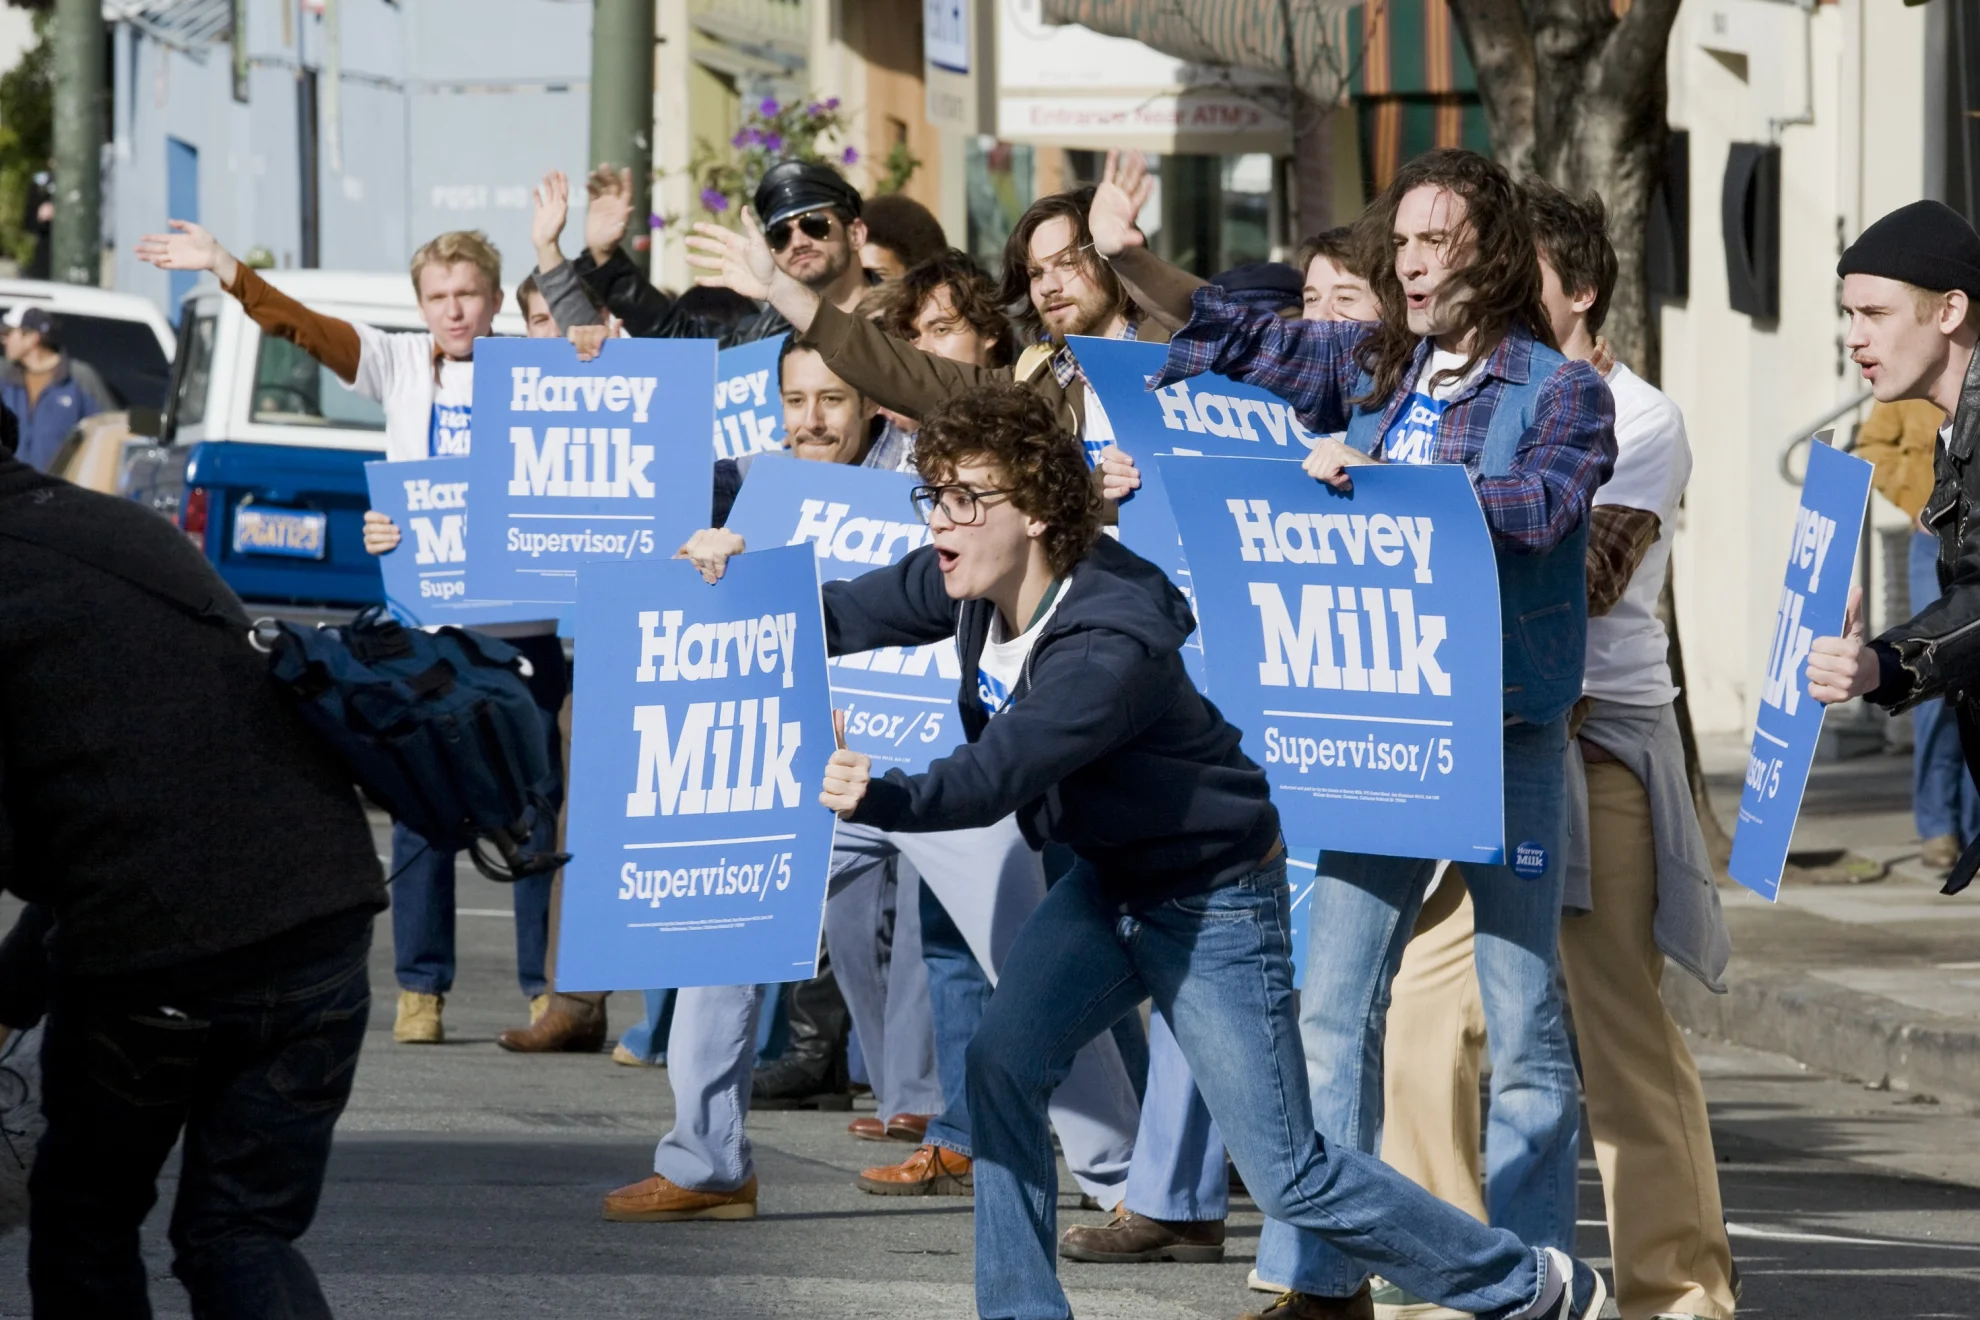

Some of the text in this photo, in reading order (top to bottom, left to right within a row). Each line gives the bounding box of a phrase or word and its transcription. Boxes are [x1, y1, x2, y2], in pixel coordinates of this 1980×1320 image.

[511, 366, 657, 423] Harvey
[508, 426, 655, 499] Milk
[713, 409, 783, 460] ilk
[403, 479, 468, 511] Har
[507, 527, 654, 559] Supervisor/5
[1226, 499, 1433, 584] Harvey
[636, 610, 796, 689] Harvey
[1248, 582, 1451, 696] Milk
[626, 696, 801, 817] Milk
[1265, 727, 1453, 782] Supervisor/5
[1516, 846, 1544, 857] Harvey
[1516, 855, 1544, 867] Milk
[619, 853, 792, 909] Supervisor/5
